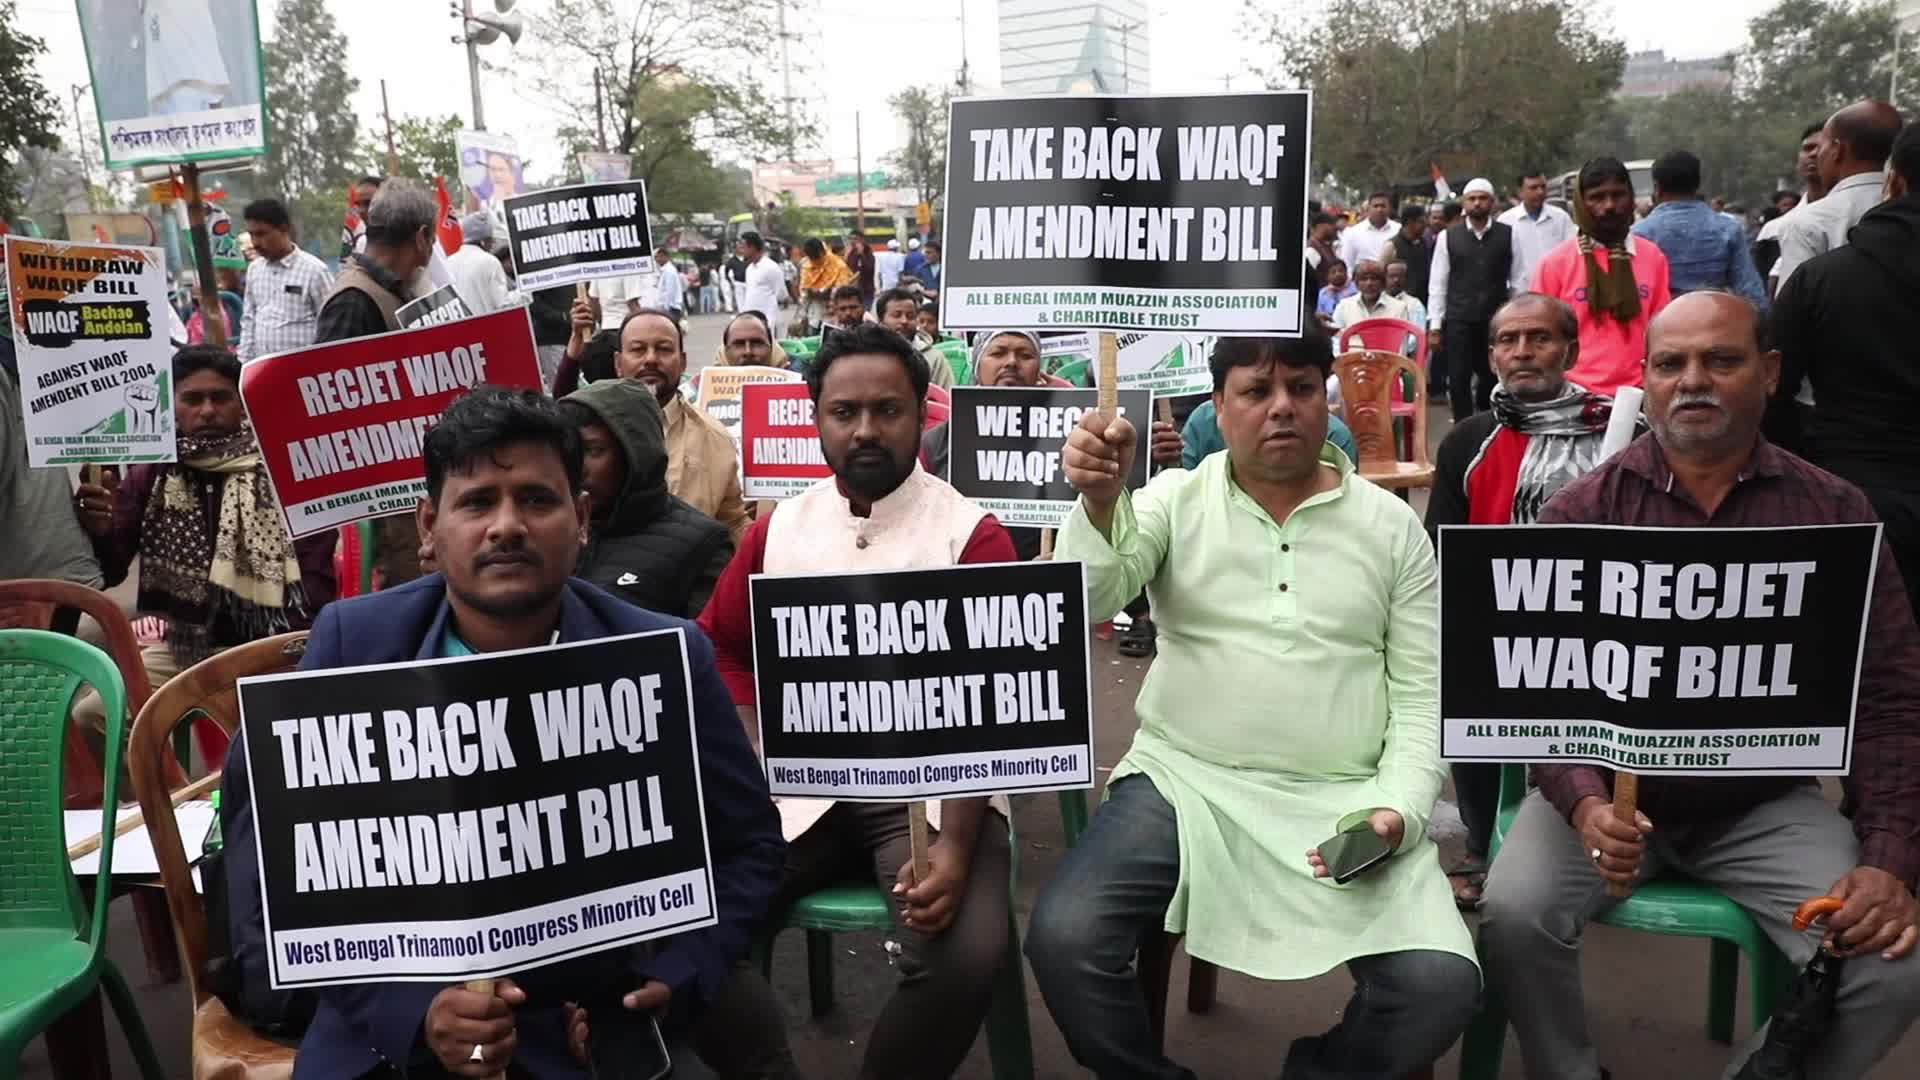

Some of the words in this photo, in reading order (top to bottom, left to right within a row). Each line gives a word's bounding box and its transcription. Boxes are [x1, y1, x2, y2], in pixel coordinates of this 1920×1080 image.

[970, 127, 1054, 182] TAKE
[1062, 126, 1162, 181] BACK
[1177, 124, 1286, 185] WAQF
[512, 204, 548, 231] TAKE
[548, 198, 590, 225] BACK
[593, 192, 637, 218] WAQF
[520, 228, 607, 263] AMENDMENT
[608, 224, 641, 250] BILL
[968, 205, 1194, 261] AMENDMENT
[1201, 206, 1277, 261] BILL
[18, 252, 145, 275] WITHDRAW
[26, 274, 88, 294] WAQF
[94, 280, 139, 295] BILL
[966, 293, 989, 306] ALL
[993, 293, 1049, 306] BENGAL
[1053, 293, 1096, 306] IMAM
[1100, 294, 1169, 308] MUAZZIN
[1172, 295, 1277, 309] ASSOCIATION
[27, 311, 79, 334] WAQF
[81, 305, 133, 320] Bachao
[84, 320, 144, 335] Andolan
[1038, 312, 1048, 323] &
[1052, 311, 1145, 325] CHARITABLE
[1148, 313, 1199, 327] TRUST
[30, 382, 89, 414] AMENDENT
[91, 374, 120, 392] BILL
[120, 363, 156, 384] 2004
[37, 362, 88, 390] AGAINST
[89, 350, 128, 372] WAQF
[297, 360, 402, 417] RECJET
[401, 342, 487, 397] WAQF
[976, 406, 1022, 437] WE
[287, 413, 443, 482] AMENDME
[976, 450, 1059, 486] WAQF
[304, 502, 325, 515] ALL
[326, 491, 374, 510] BENGAL
[375, 484, 409, 498] IMAM
[368, 504, 377, 513] &
[379, 497, 417, 512] CHARI
[1491, 558, 1584, 612] WE
[1599, 560, 1817, 620] RECJET
[771, 604, 850, 658] TAKE
[855, 599, 951, 656] BACK
[962, 592, 1065, 651] WAQF
[1493, 637, 1664, 702] WAQF
[1676, 643, 1798, 699] BILL
[782, 674, 986, 733] AMENDMENT
[993, 669, 1066, 725] BILL
[271, 712, 380, 789] TAKE
[382, 697, 517, 781] BACK
[529, 673, 663, 762] WAQF
[1466, 724, 1493, 737] ALL
[1498, 725, 1561, 738] BENGAL
[1566, 725, 1613, 740] IMAM
[1618, 733, 1695, 748] MUAZZIN
[1698, 733, 1820, 748] ASSOCIATION
[773, 766, 805, 784] West
[807, 767, 850, 787] Bengal
[852, 765, 921, 785] Trinamool
[924, 761, 988, 784] Congress
[991, 755, 1048, 779] Minority
[1050, 754, 1077, 773] Cell
[1548, 744, 1560, 754] &
[1565, 742, 1668, 766] CHARITABLE
[1672, 753, 1731, 766] TRUST
[294, 794, 568, 893] AMENDMENT
[577, 775, 673, 859] BILL
[284, 939, 332, 966] West
[335, 933, 395, 963] Bengal
[396, 930, 485, 959] Trinamool
[488, 913, 579, 953] Congress
[581, 892, 656, 930] Minority
[660, 883, 695, 911] Cell
